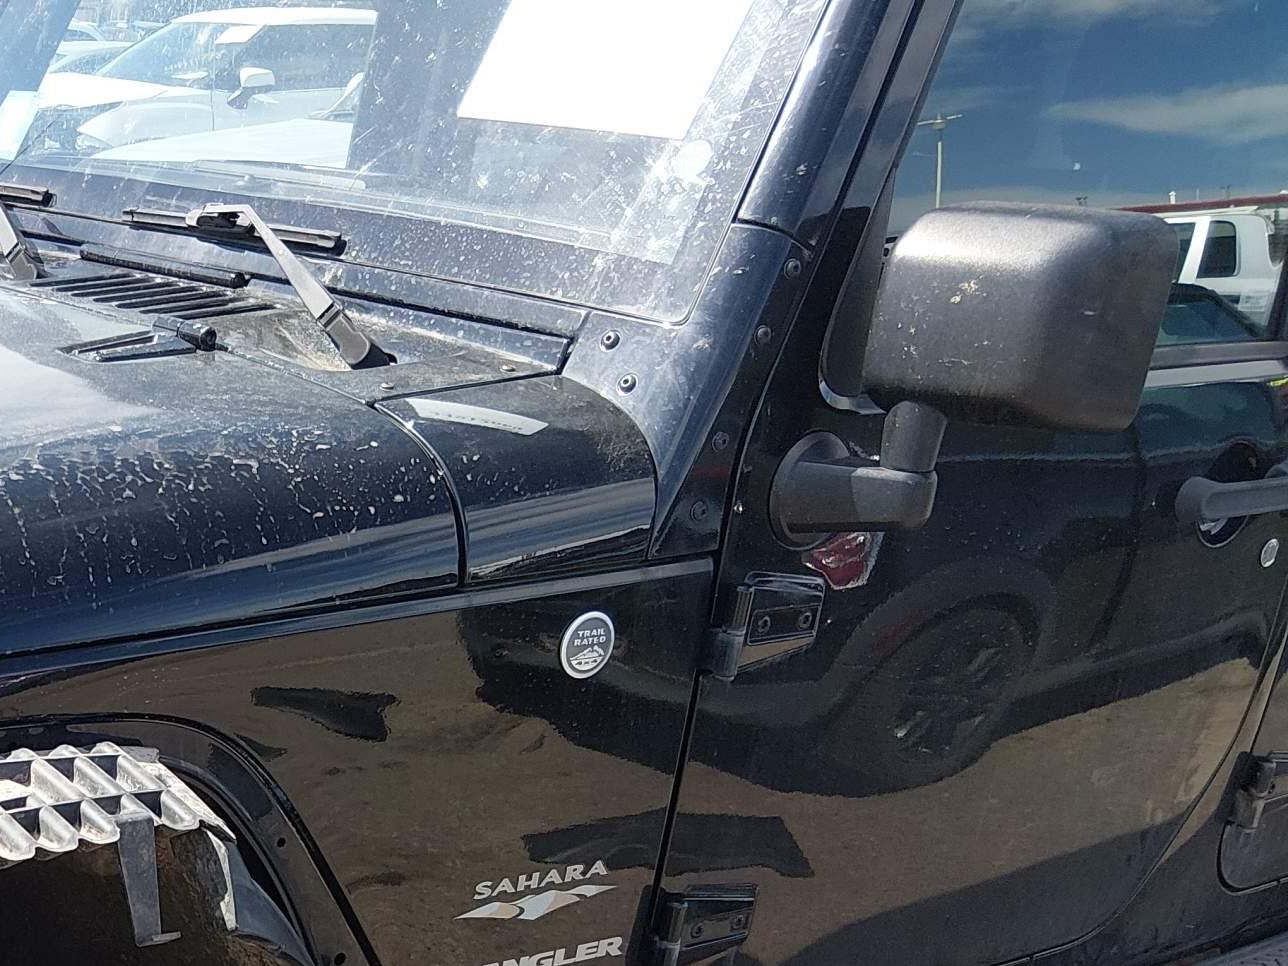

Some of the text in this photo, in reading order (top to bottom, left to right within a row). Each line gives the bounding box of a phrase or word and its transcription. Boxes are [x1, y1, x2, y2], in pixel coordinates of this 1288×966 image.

[577, 628, 606, 637] TRAIL
[574, 636, 606, 647] RATED
[473, 860, 608, 900] SAHARA
